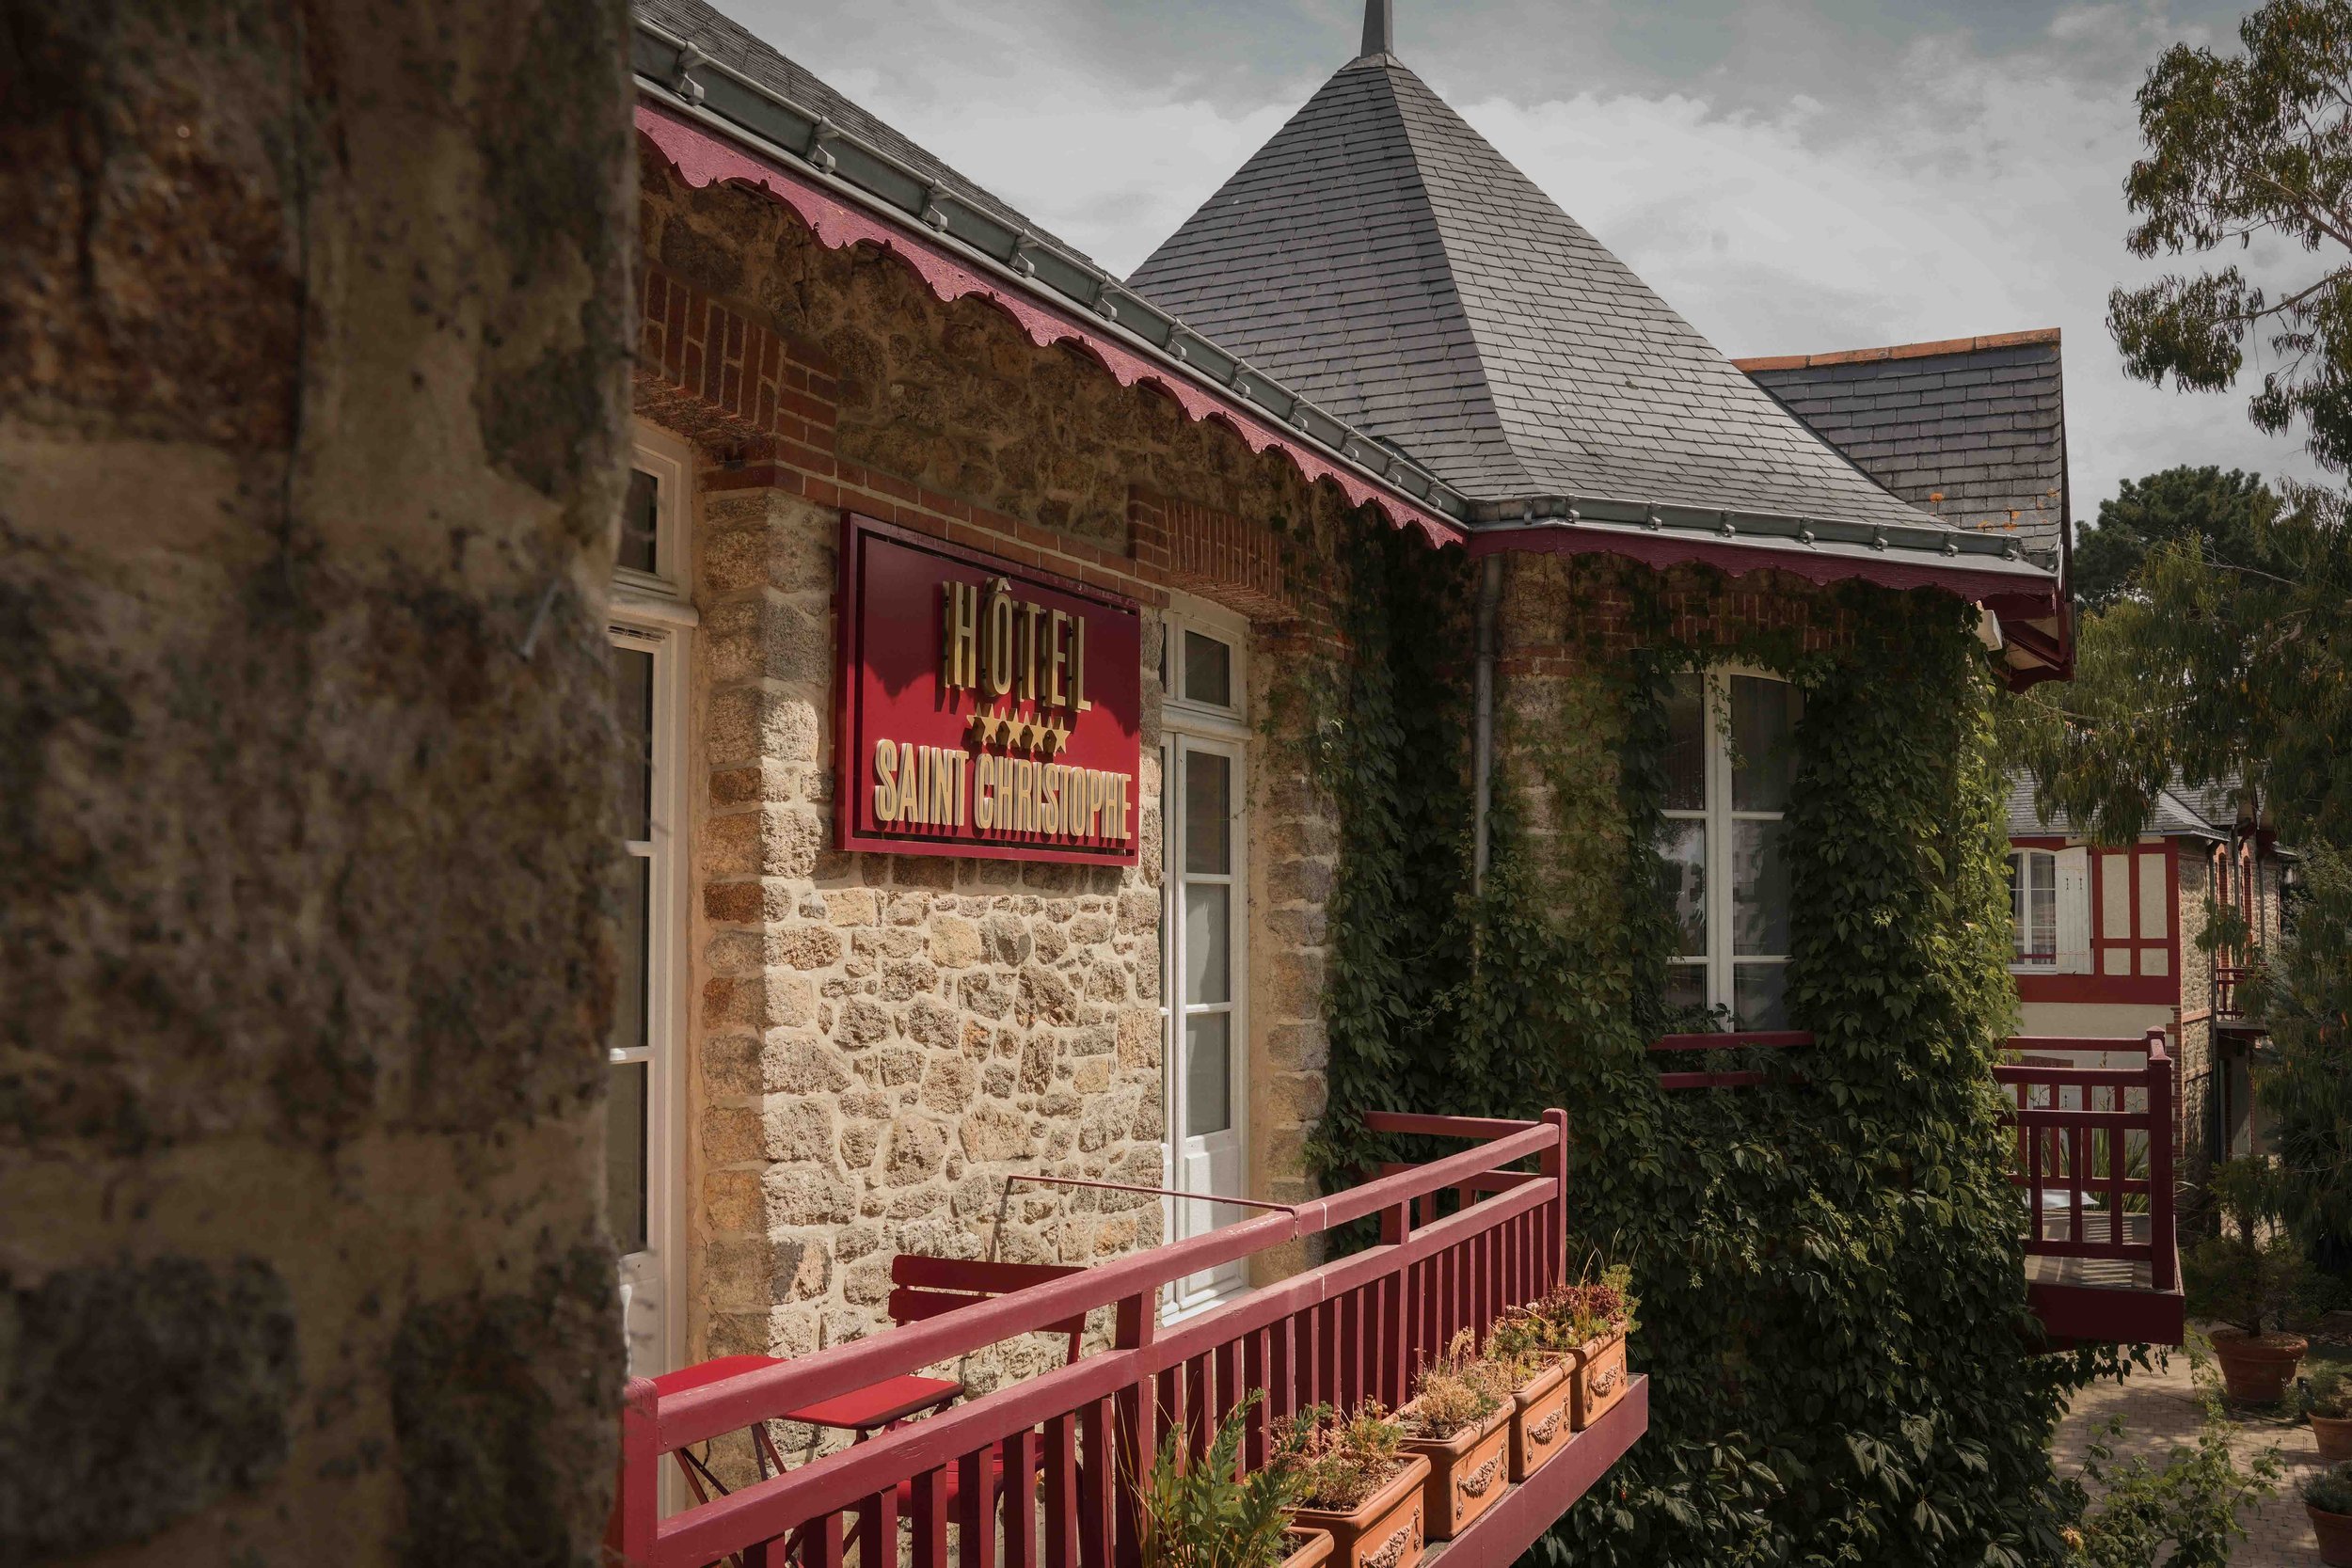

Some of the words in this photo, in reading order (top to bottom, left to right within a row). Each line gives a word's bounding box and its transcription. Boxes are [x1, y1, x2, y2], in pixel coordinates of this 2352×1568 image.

[943, 578, 1091, 712] HÔTEL
[875, 738, 969, 827] SAINT
[975, 752, 1132, 840] CHRISTOPHE
